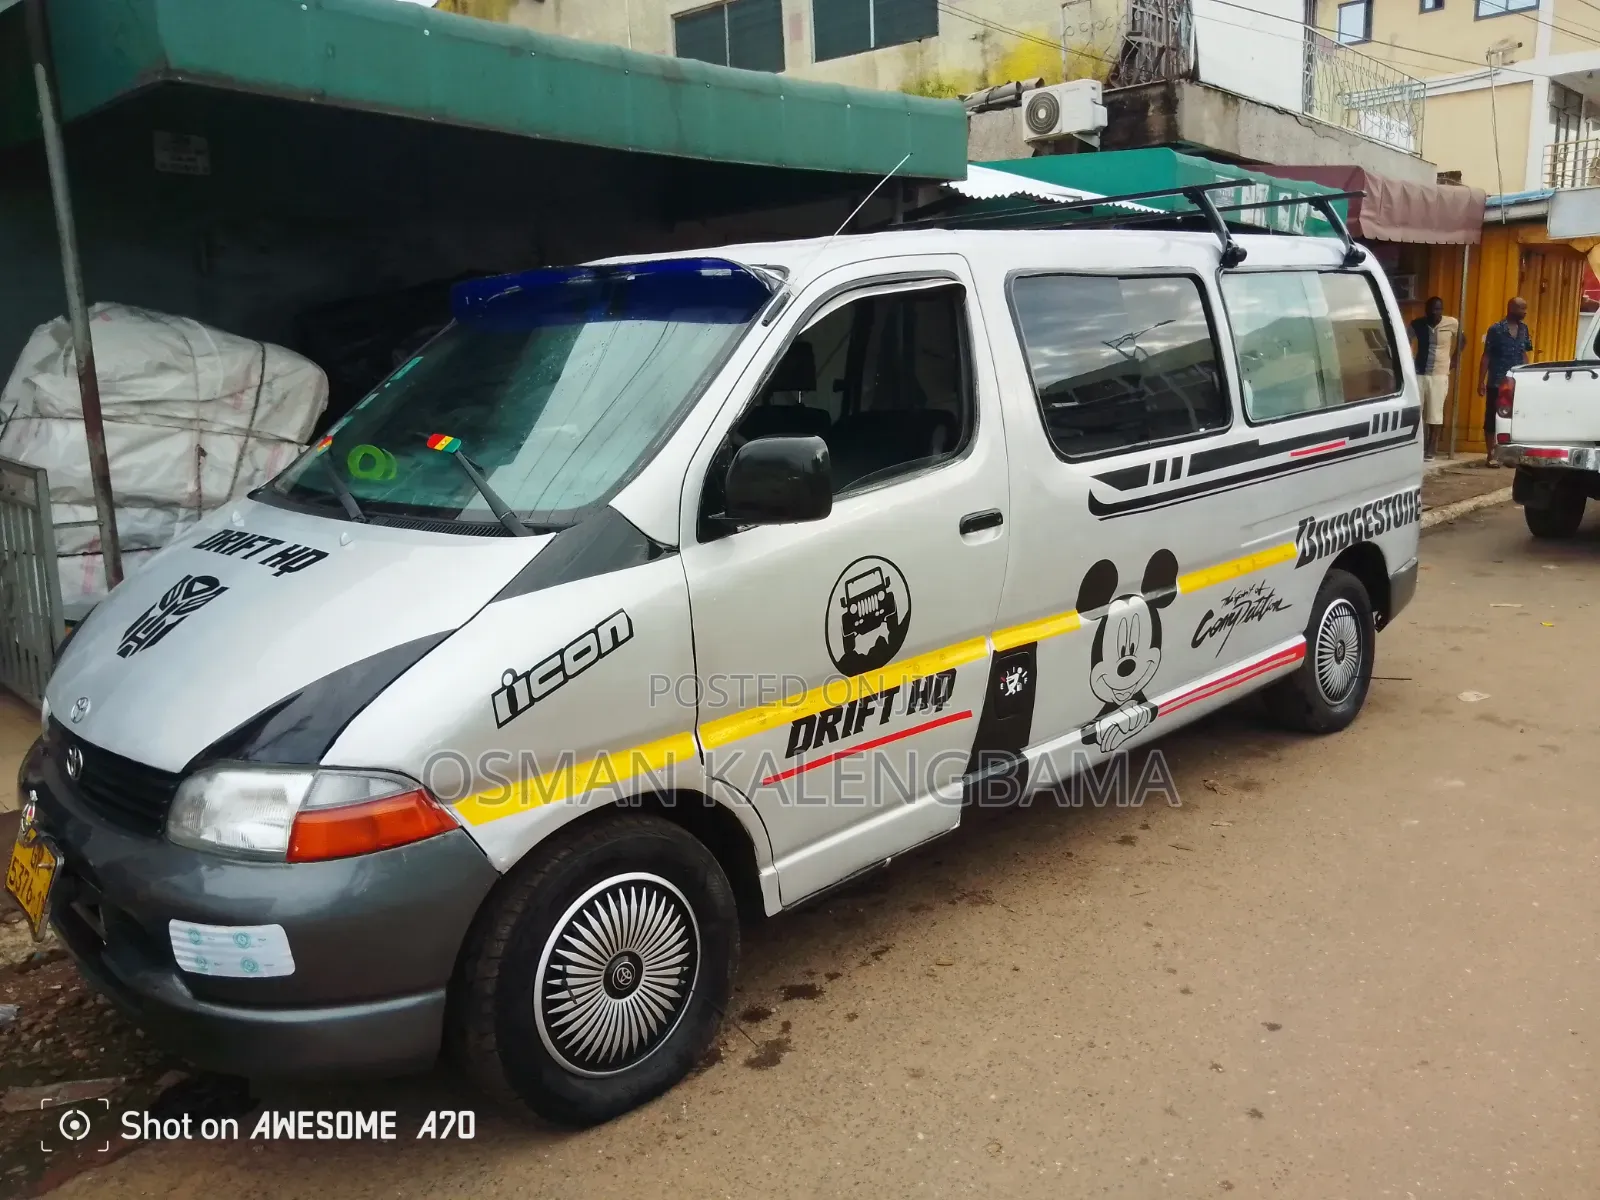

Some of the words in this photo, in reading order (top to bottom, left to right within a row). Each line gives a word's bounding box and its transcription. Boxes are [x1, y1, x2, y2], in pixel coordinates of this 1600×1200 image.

[192, 529, 286, 560] DRIFT
[258, 544, 330, 578] HQ
[1294, 487, 1421, 570] BRIDGESTONE
[785, 685, 901, 759] DRIFT
[906, 668, 957, 715] HQ
